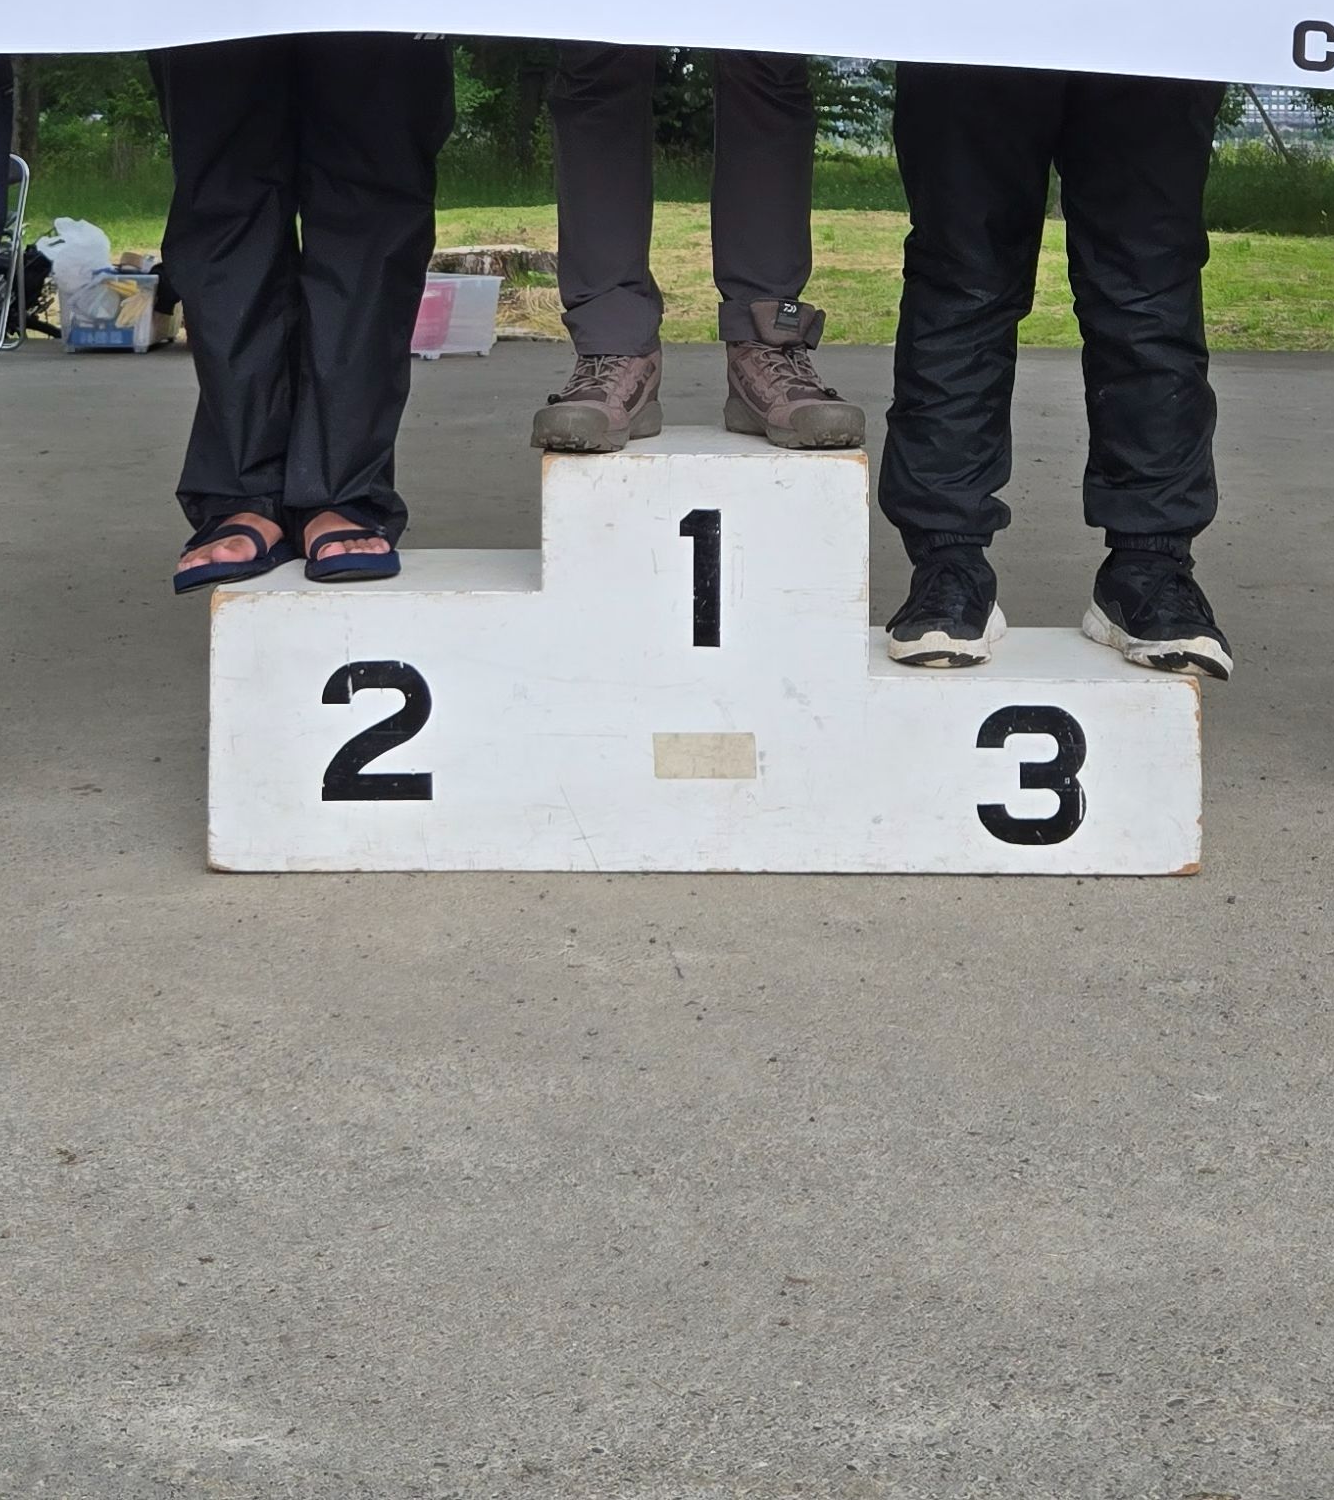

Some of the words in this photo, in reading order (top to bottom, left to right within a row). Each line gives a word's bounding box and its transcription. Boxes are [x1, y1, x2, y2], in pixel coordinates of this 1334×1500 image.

[679, 508, 723, 648] 1
[321, 660, 433, 802] 2
[975, 705, 1087, 846] 3
